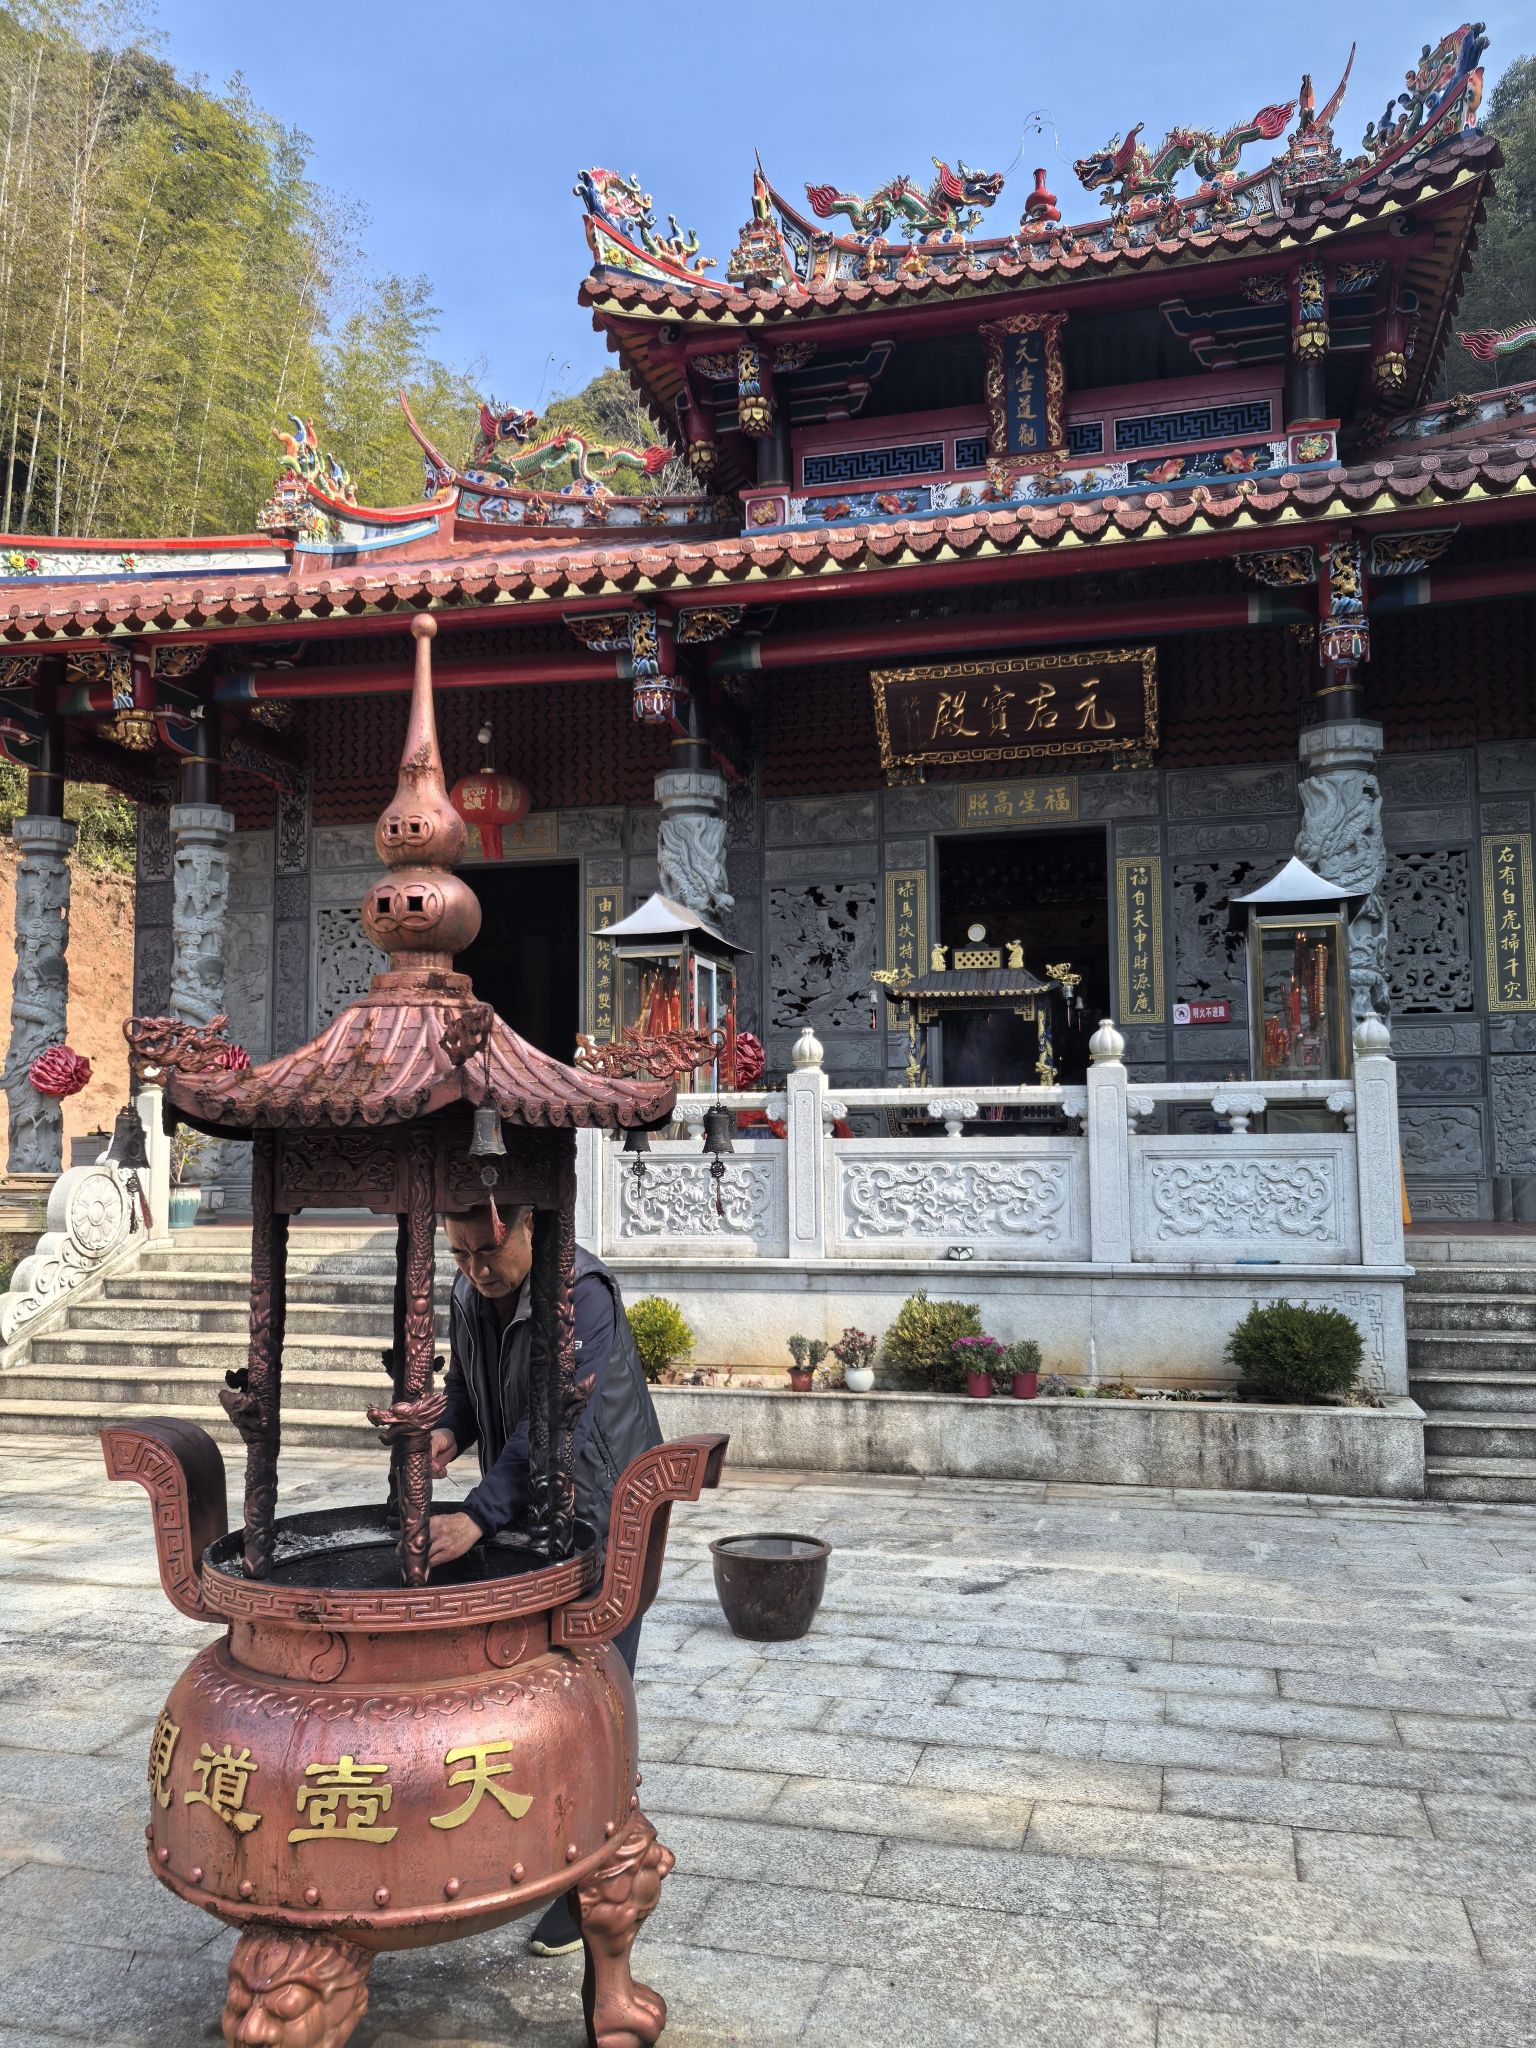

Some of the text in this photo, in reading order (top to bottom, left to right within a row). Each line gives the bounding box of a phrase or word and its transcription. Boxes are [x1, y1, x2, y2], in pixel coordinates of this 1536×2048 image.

[930, 677, 1116, 740] 元君寶殿
[967, 786, 1070, 818] 福星高照
[1129, 867, 1152, 1013] 福自天申財源廣
